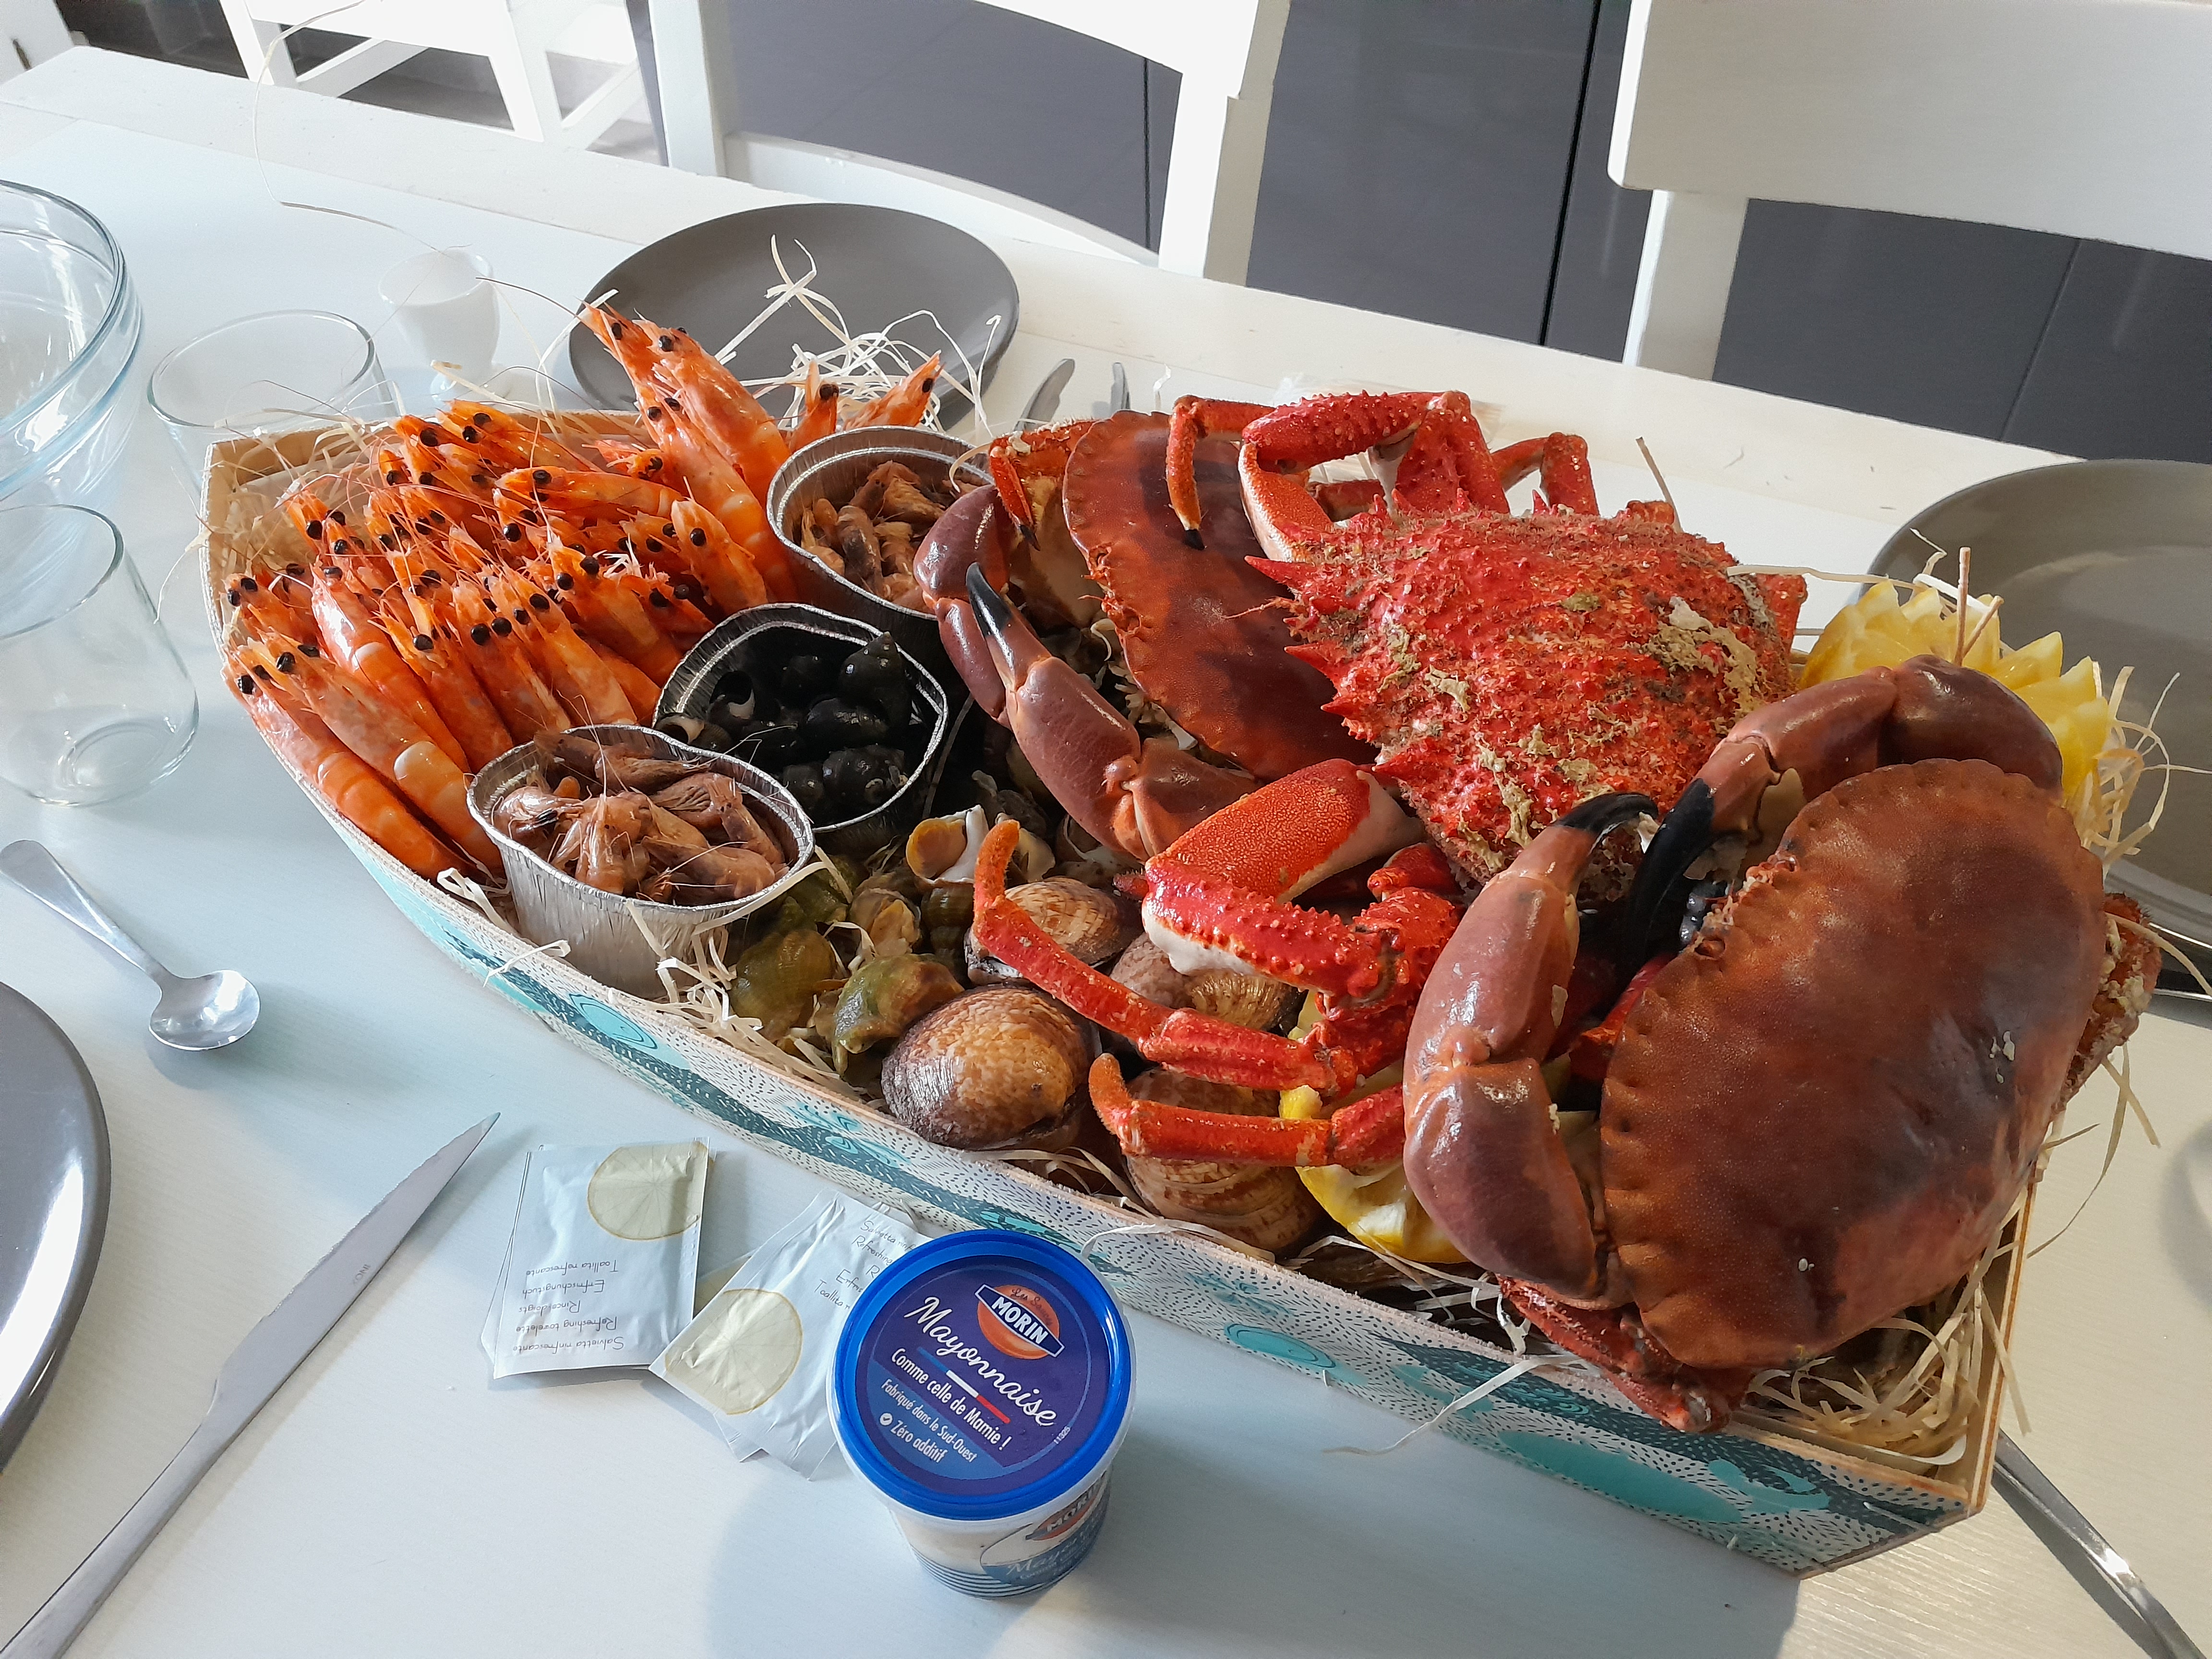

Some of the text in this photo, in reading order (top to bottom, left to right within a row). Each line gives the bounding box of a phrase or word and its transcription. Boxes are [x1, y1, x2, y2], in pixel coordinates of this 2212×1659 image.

[851, 1235, 893, 1266] Refreshing
[526, 1260, 618, 1276] Toallita refrescante
[522, 1279, 605, 1299] Erfrischungstuch
[814, 1279, 843, 1307] Toallita
[516, 1316, 617, 1336] Refreshing towelette
[991, 1296, 1049, 1345] MORIN
[513, 1336, 624, 1354] Salvietta rinfrescante
[904, 1297, 1057, 1426] Mayonnaise
[891, 1348, 1012, 1451] Comme celle de Mamie !
[881, 1379, 978, 1463] Fabriqué dans le Sud-Ouest
[890, 1420, 949, 1463] Zéro additif
